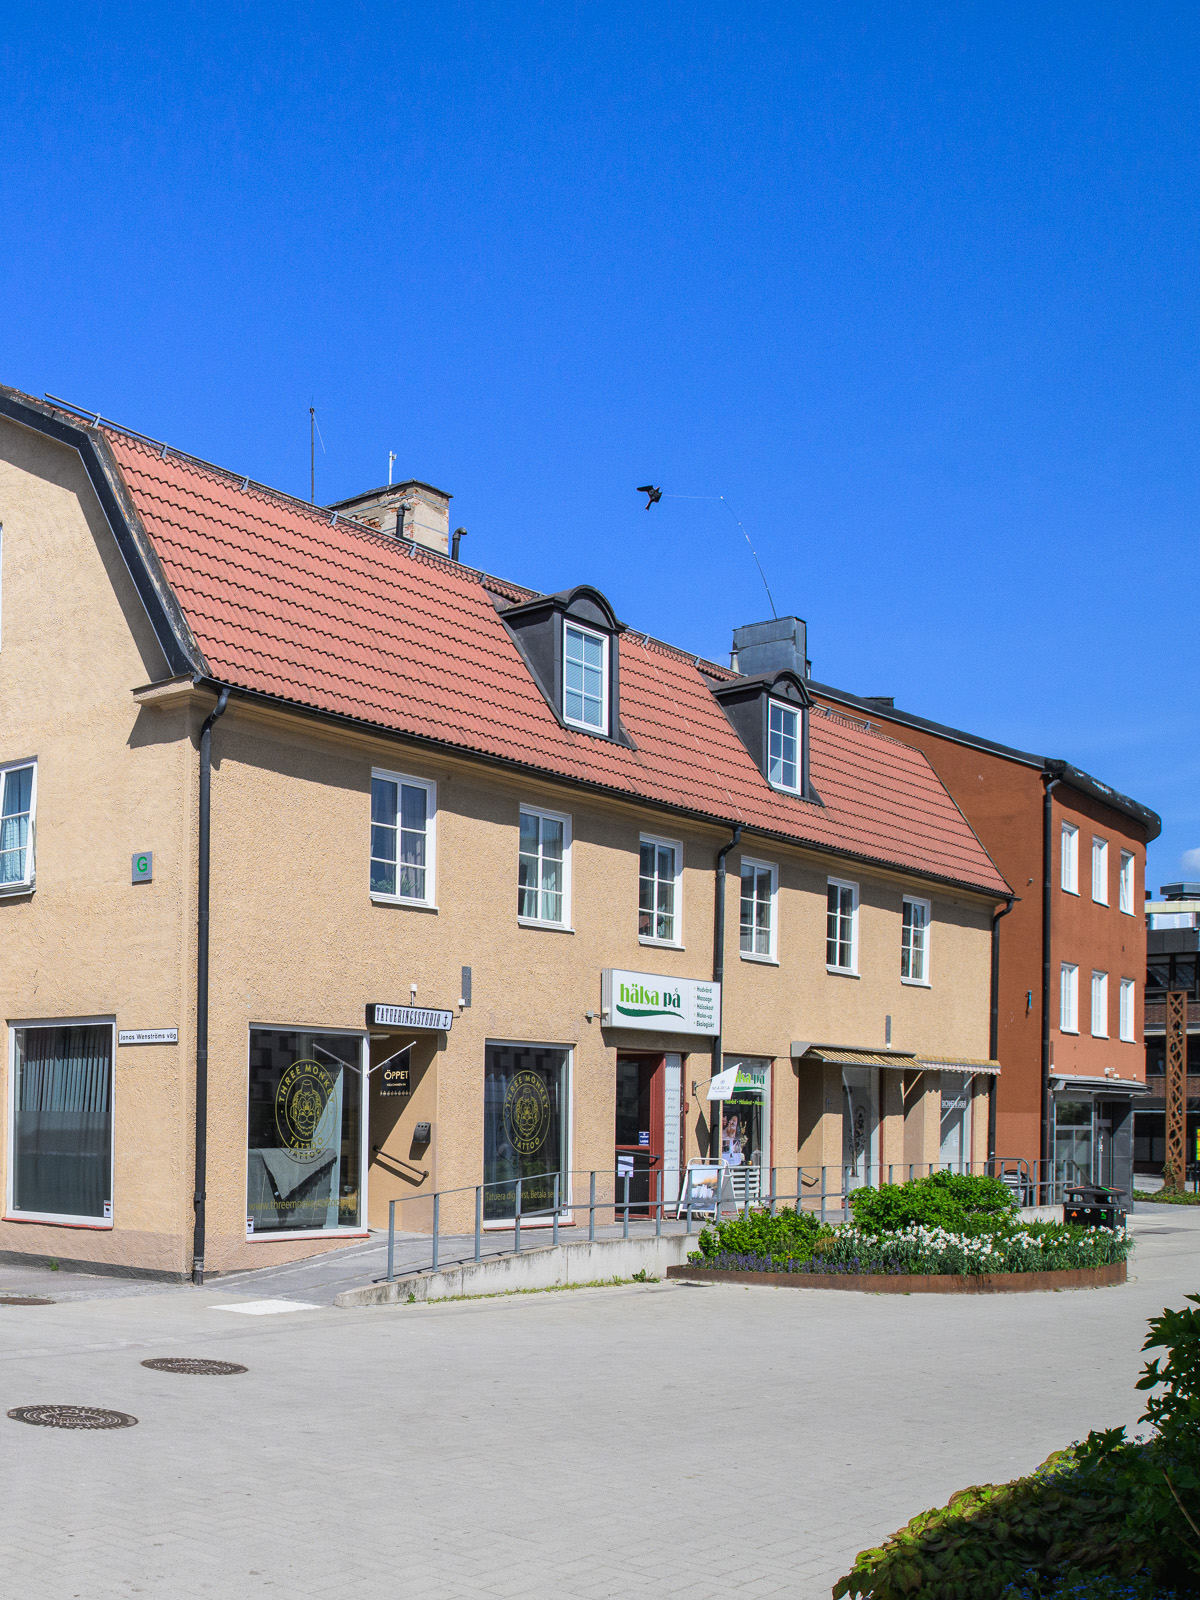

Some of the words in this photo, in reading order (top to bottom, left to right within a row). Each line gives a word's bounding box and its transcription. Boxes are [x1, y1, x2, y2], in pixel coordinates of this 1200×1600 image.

[136, 856, 148, 873] G
[620, 983, 660, 1006] hälsa
[663, 987, 681, 1008] på
[696, 986, 712, 994] Hudvård
[696, 994, 713, 1004] Massage
[376, 1006, 441, 1028] TATUERINGSSTUDIO
[696, 1011, 713, 1020] Make-up
[696, 1020, 715, 1029] Ekologiskt
[136, 1032, 166, 1040] Wenströms
[383, 1069, 409, 1080] ÖPPET
[278, 1065, 302, 1103] THREE
[304, 1063, 335, 1103] MONKEY
[505, 1076, 523, 1108] THREE
[525, 1074, 549, 1109] MONKEY
[289, 1136, 324, 1151] TATTOO
[514, 1137, 540, 1151] TATTOO
[485, 1191, 506, 1201] Tatuera
[506, 1191, 516, 1202] dig
[530, 1189, 547, 1199] Betala
